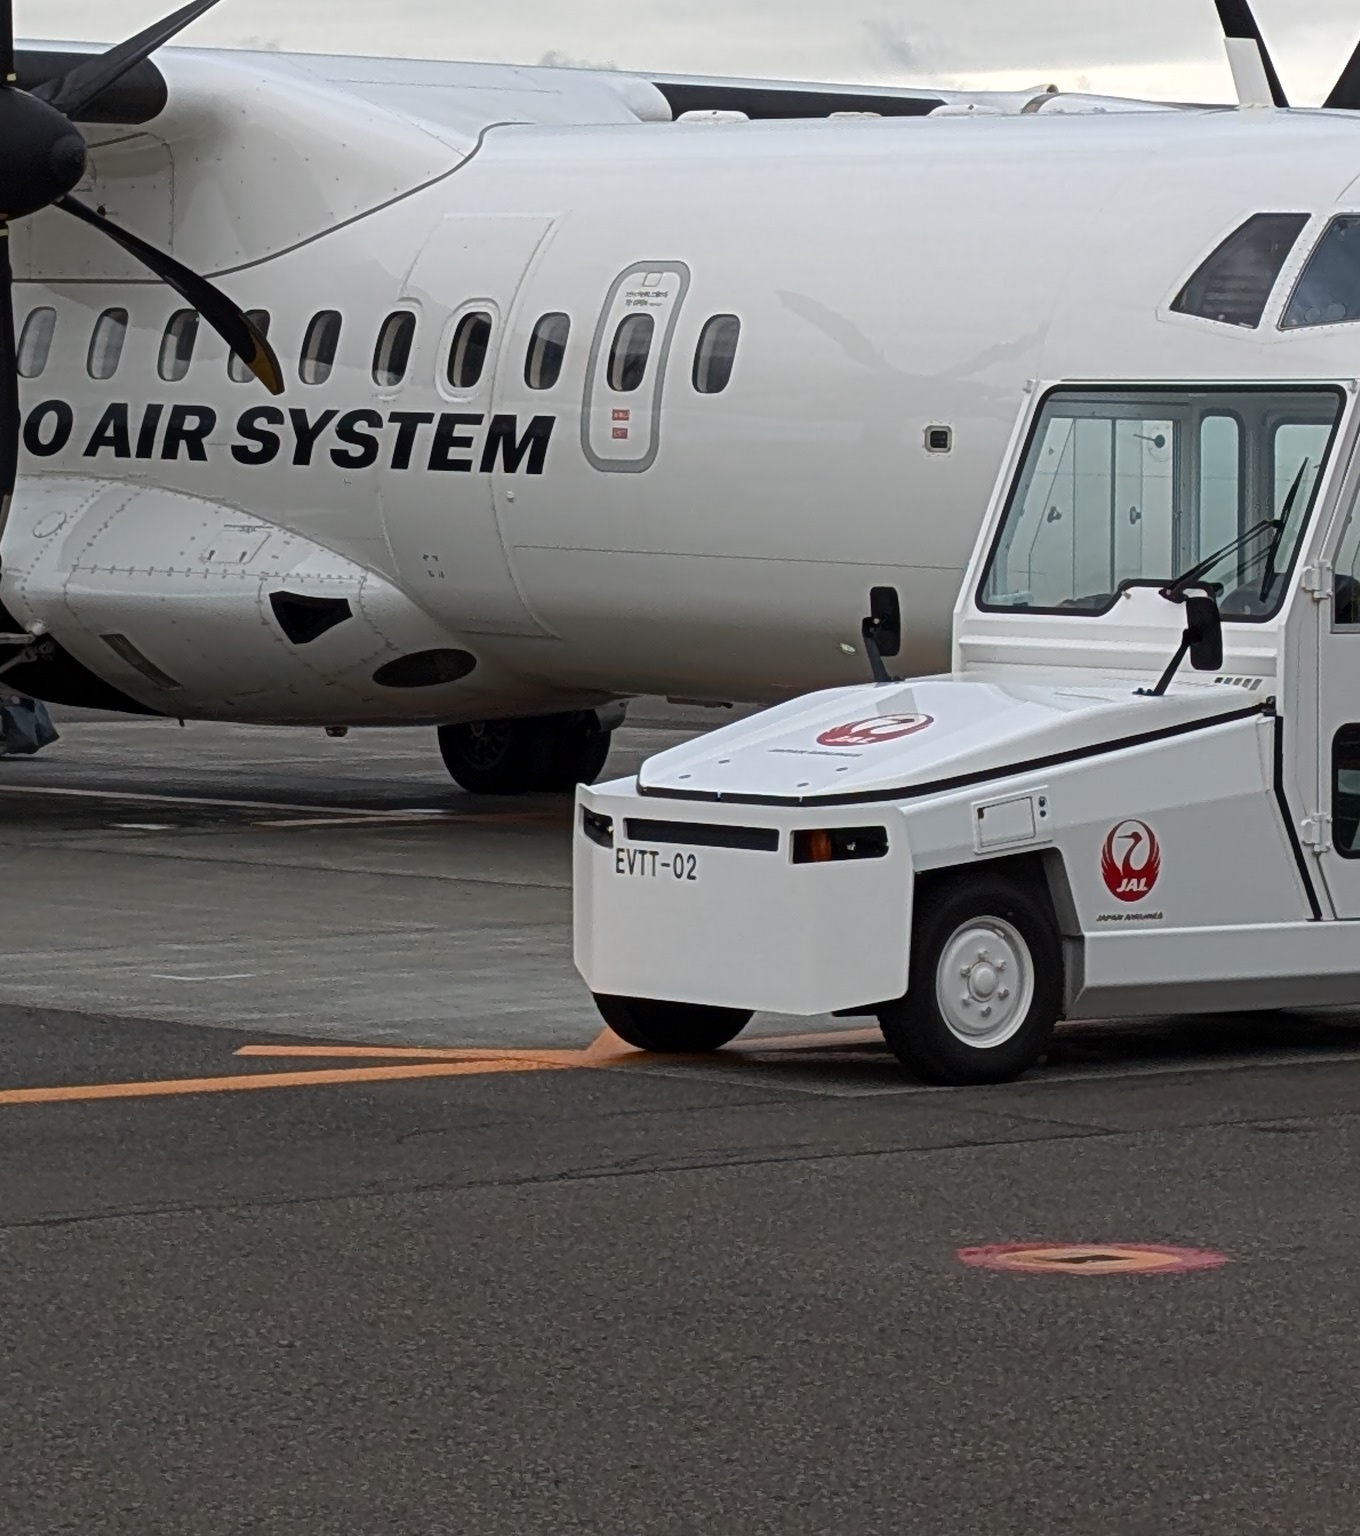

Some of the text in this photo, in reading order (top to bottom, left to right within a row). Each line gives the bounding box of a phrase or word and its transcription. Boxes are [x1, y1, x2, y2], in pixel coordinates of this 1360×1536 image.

[83, 403, 217, 462] AIR
[231, 405, 557, 475] SYSTEM
[615, 847, 698, 881] EVTT-02
[1115, 877, 1149, 893] JAL
